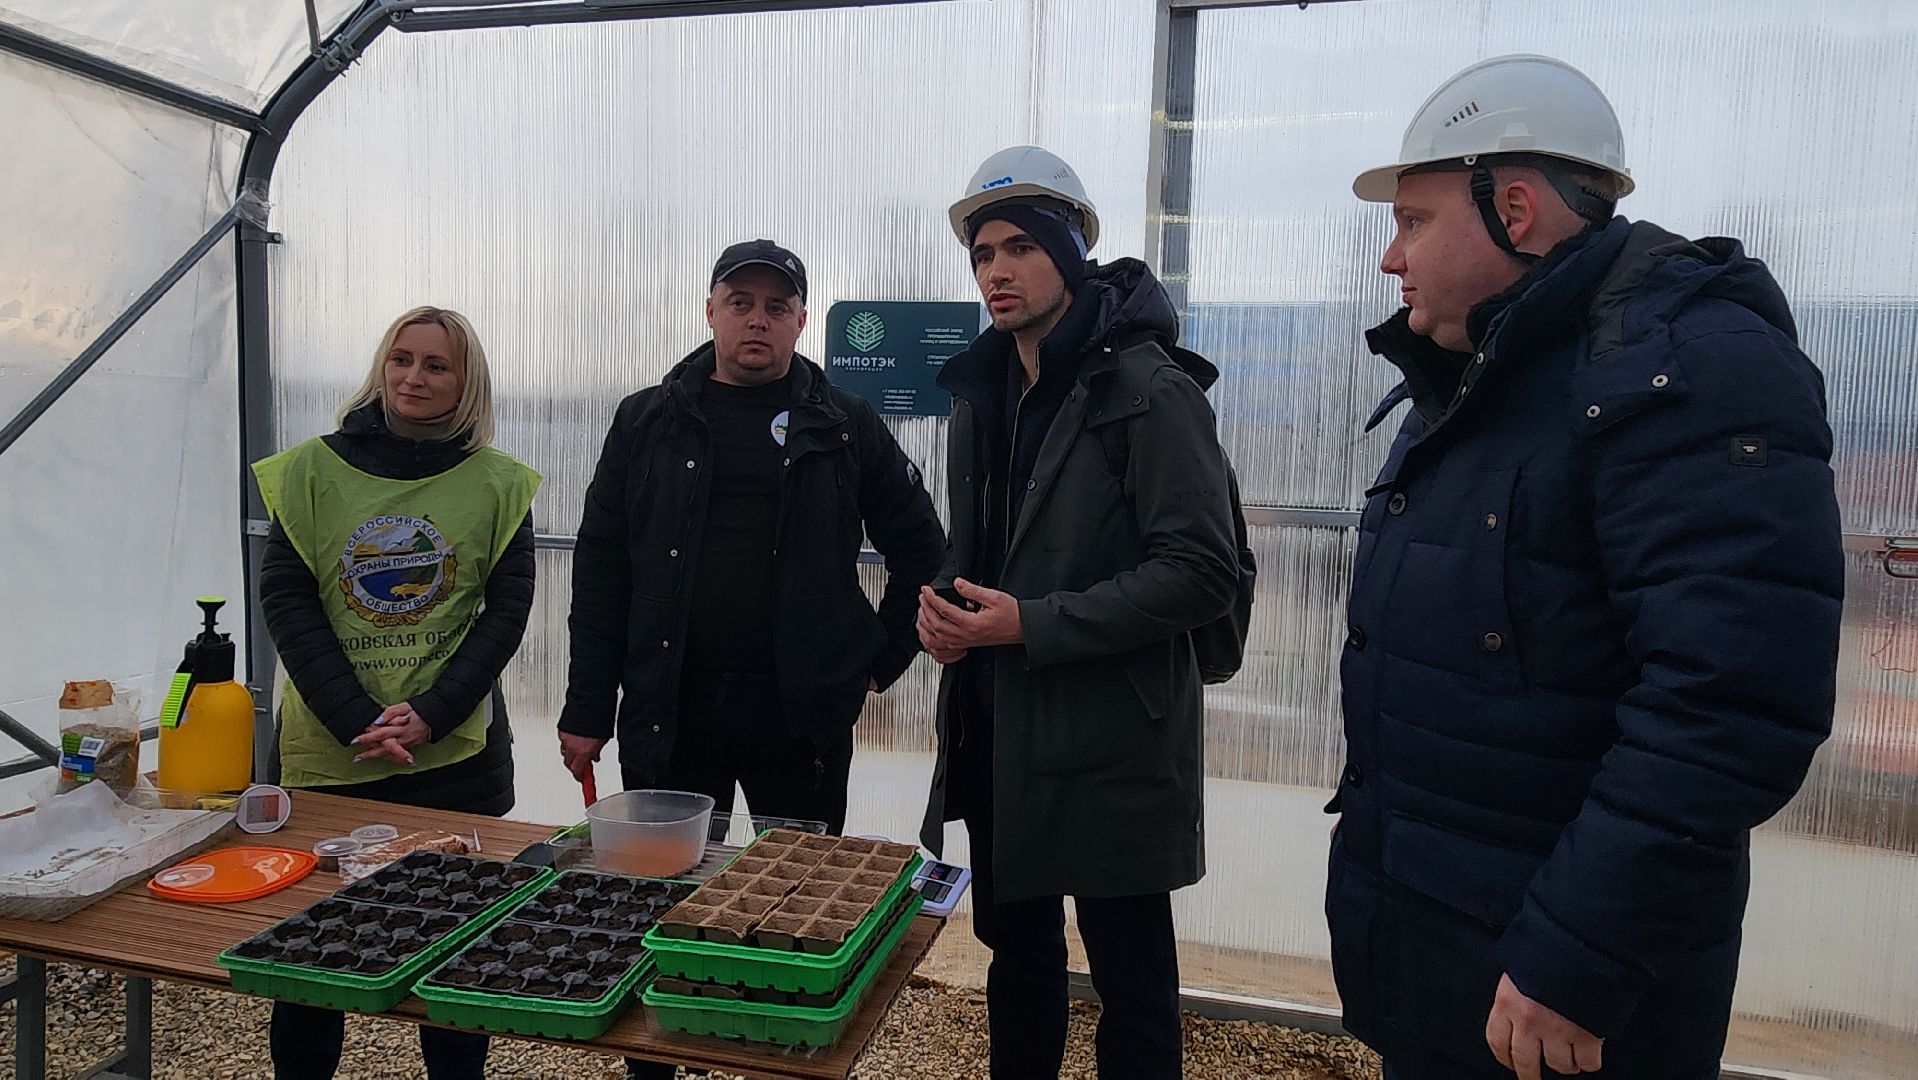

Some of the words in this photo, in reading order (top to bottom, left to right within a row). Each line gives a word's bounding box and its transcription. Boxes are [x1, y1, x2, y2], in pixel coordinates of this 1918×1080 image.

[832, 356, 896, 368] ИМПОТЭК
[347, 558, 391, 579] ОХРАНЫ
[393, 550, 445, 567] ПРИРОДЫ
[365, 594, 430, 613] ОБЩЕСТВО
[338, 632, 417, 652] КОВСКАЯ
